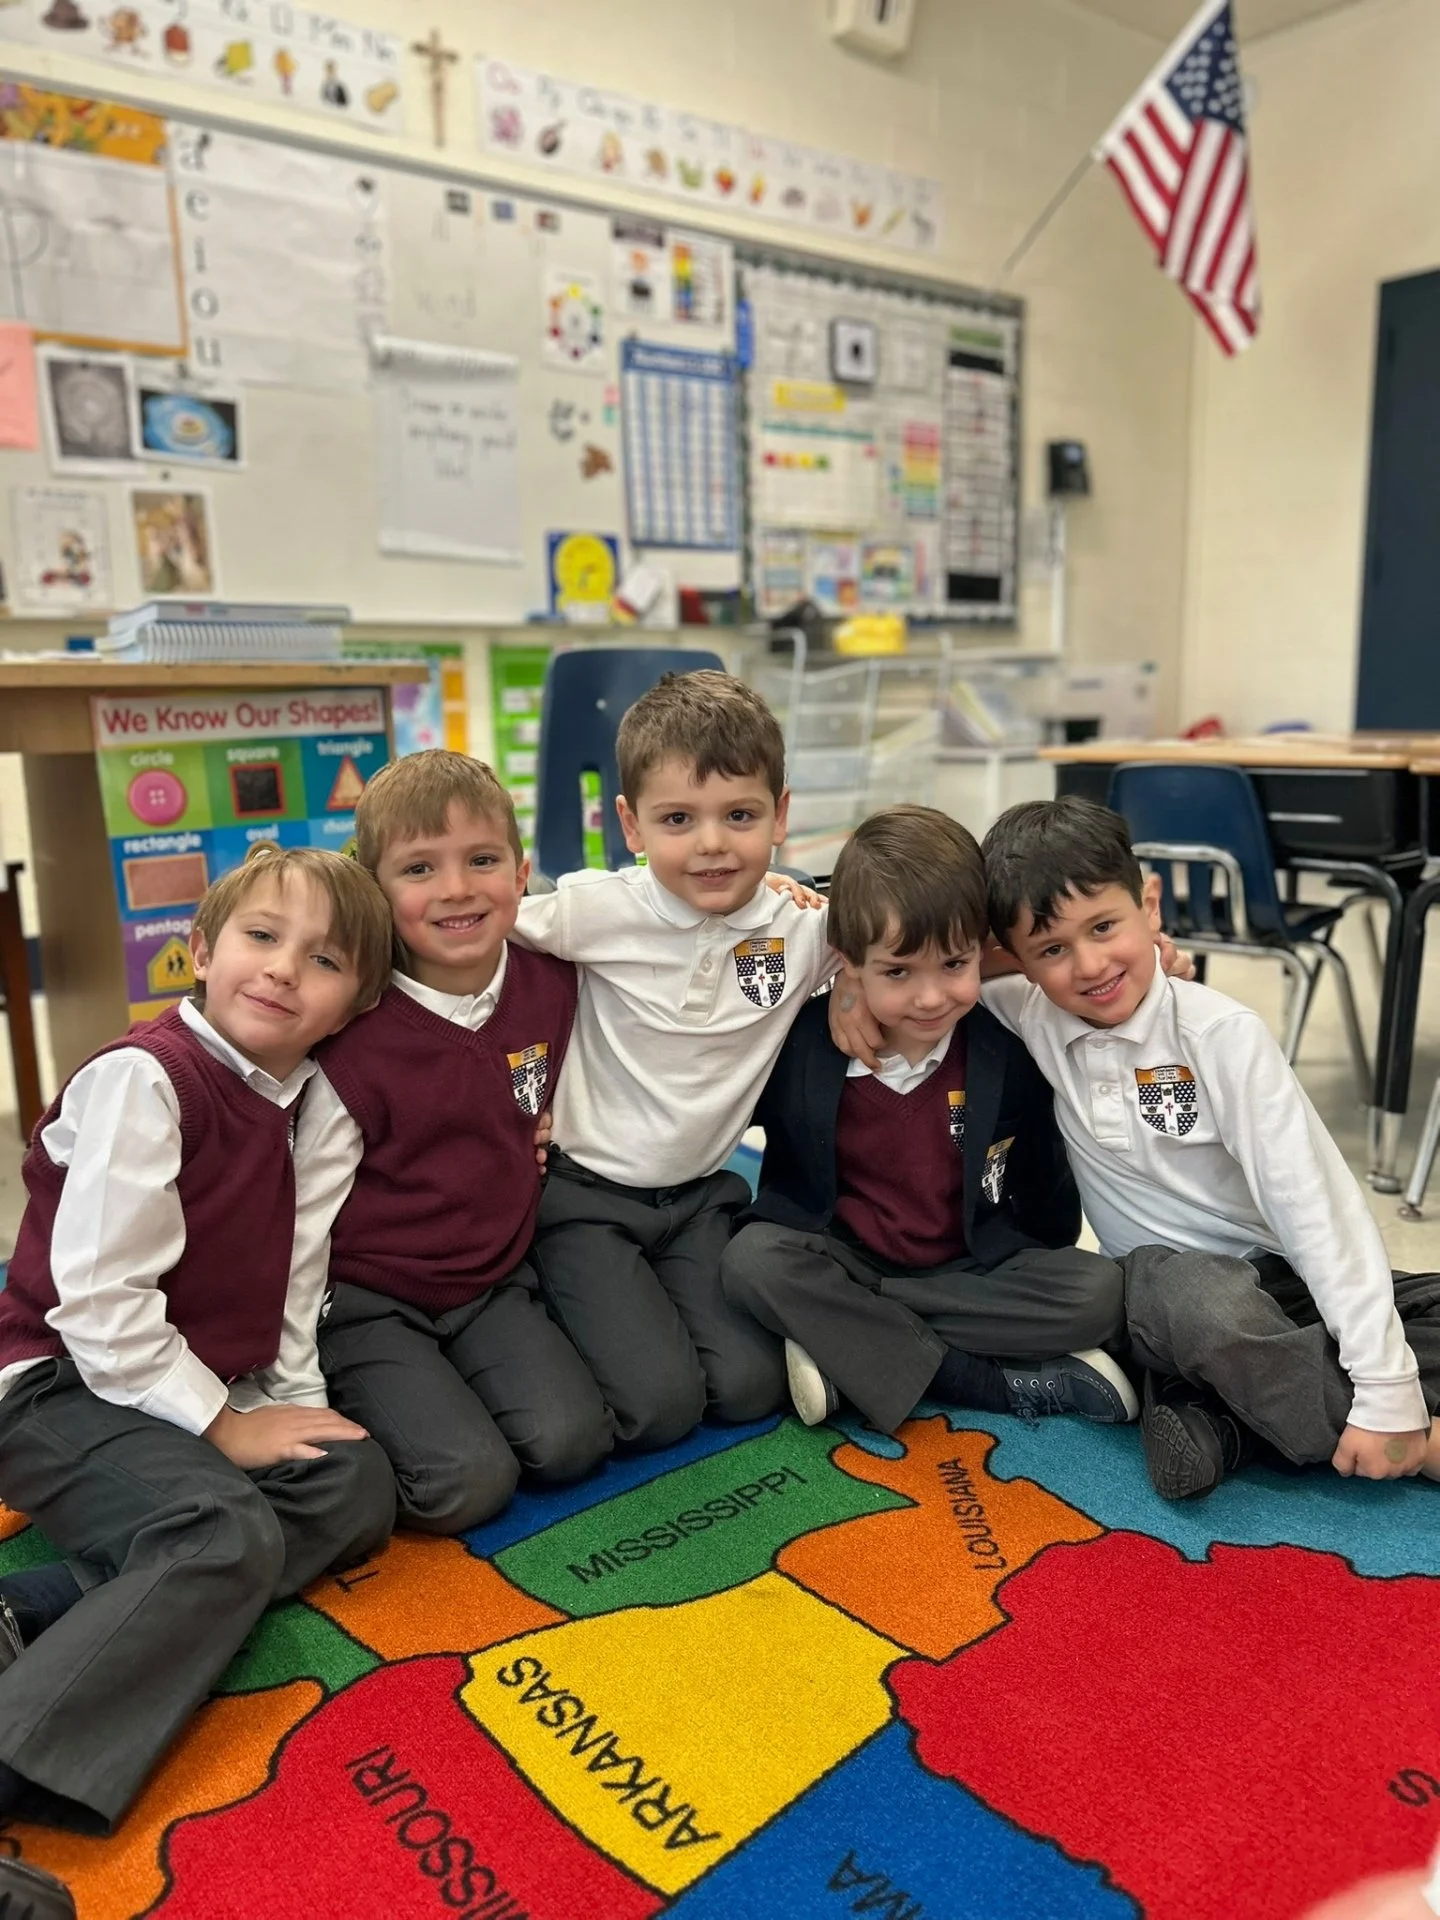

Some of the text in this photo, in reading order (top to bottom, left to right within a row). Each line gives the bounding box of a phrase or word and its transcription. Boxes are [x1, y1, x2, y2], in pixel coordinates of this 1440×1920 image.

[101, 696, 378, 734] We Know Our Shapes!
[129, 749, 175, 768] circle
[226, 746, 280, 765] square
[316, 737, 374, 758] triangle
[123, 831, 202, 854] rectangle
[245, 822, 279, 842] oval
[133, 918, 193, 942] pentag
[566, 1467, 808, 1584] MISSISSIPPI
[936, 1457, 1007, 1571] LOUISIANA
[497, 1656, 722, 1850] ARKANSAS
